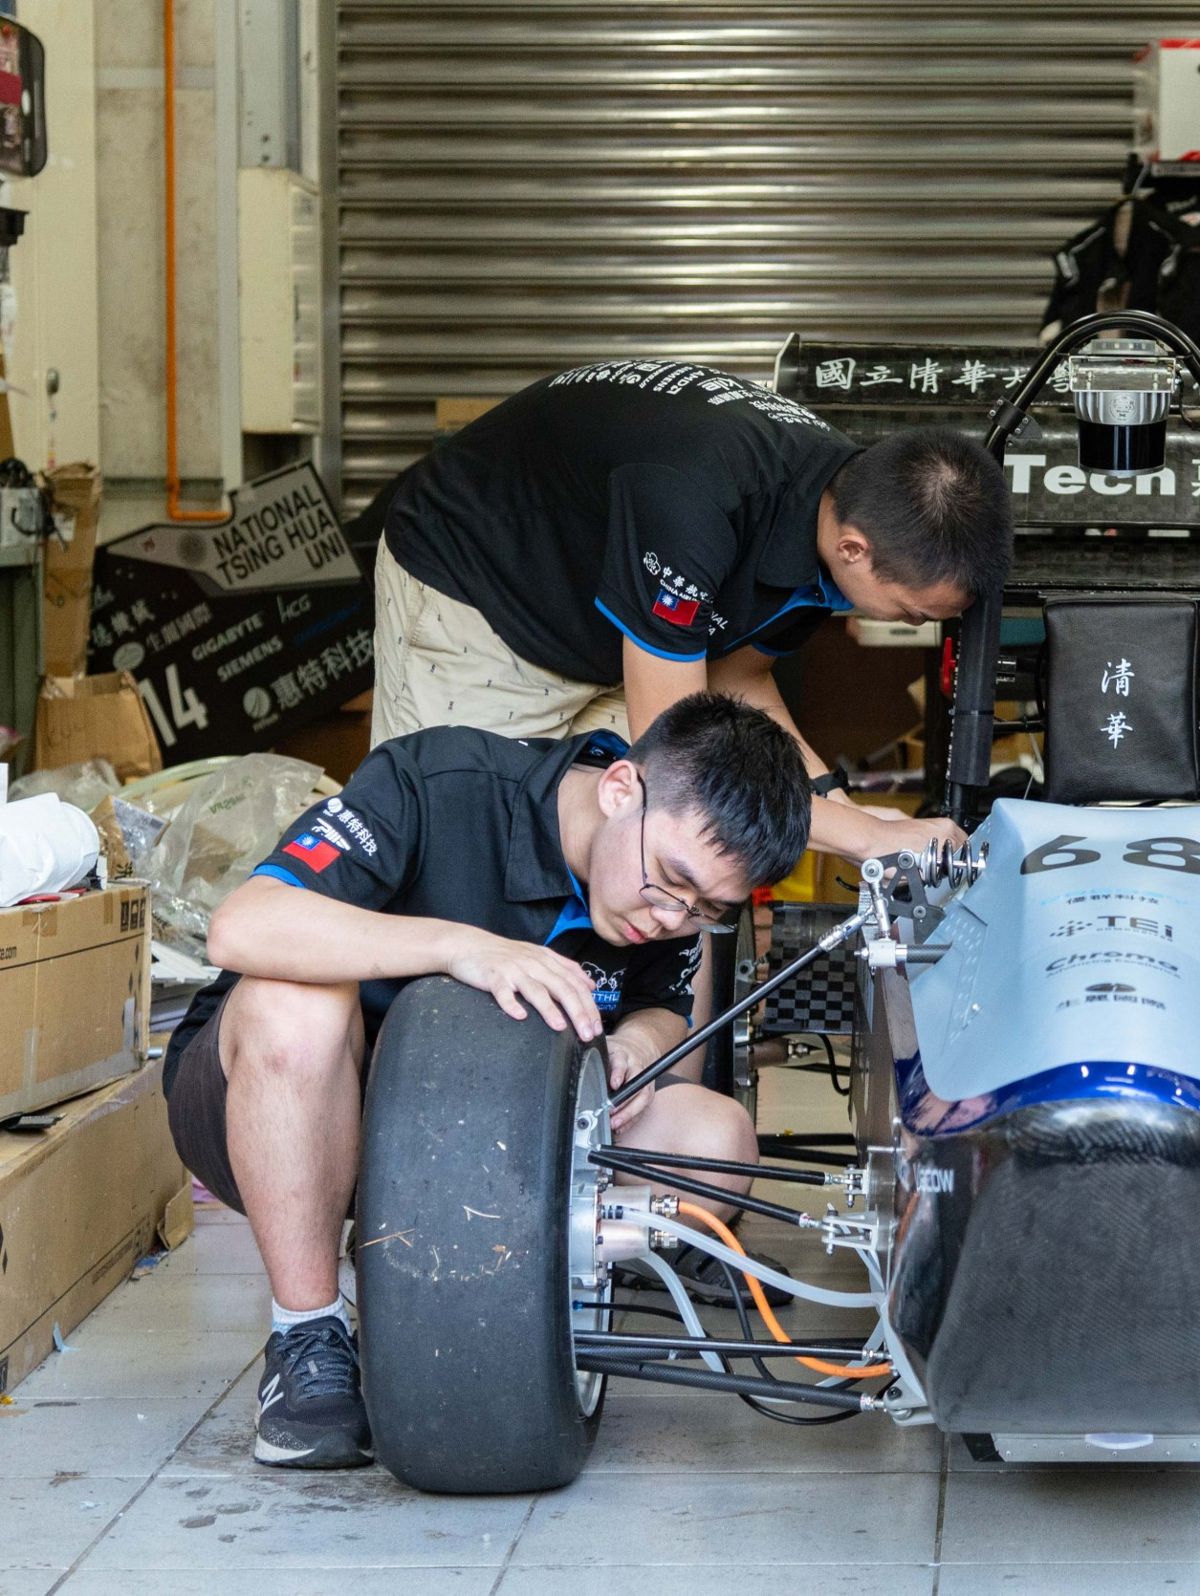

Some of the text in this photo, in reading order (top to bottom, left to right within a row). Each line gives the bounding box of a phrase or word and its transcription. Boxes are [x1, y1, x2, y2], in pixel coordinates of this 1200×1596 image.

[212, 484, 322, 558] NATIONAL
[216, 508, 337, 586] TSING HUA
[303, 535, 346, 571] UNI
[191, 613, 265, 661] GIGABYTE
[216, 635, 284, 683] SIEMENS
[138, 663, 208, 748] 14
[1101, 658, 1134, 748] 清華
[1046, 951, 1179, 971] Chroma
